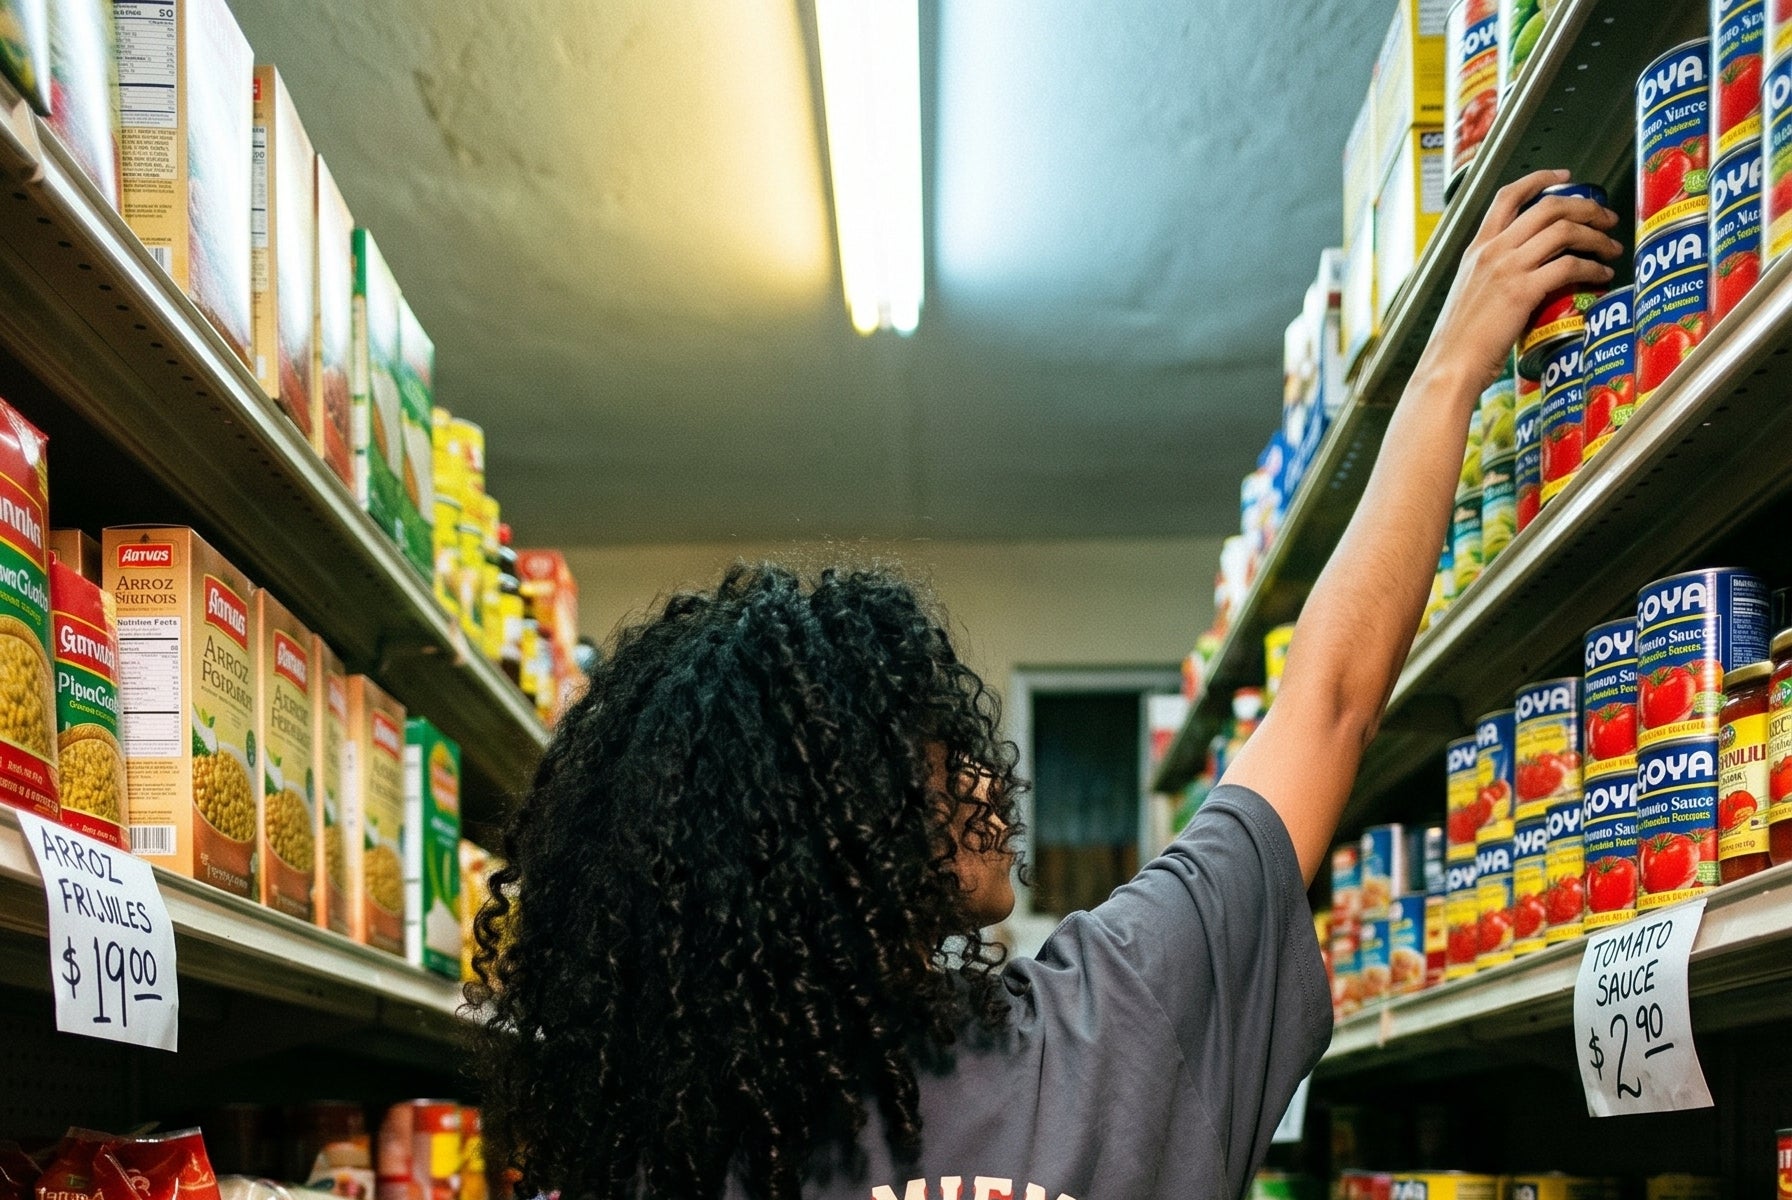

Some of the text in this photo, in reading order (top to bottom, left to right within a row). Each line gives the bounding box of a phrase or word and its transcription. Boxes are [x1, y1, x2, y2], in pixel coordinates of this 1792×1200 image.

[116, 575, 174, 591] ARROZ
[203, 634, 249, 685] ARROZ
[1585, 629, 1637, 669] GOY
[1637, 750, 1714, 794] GOYA
[1671, 796, 1714, 811] Sauce
[40, 825, 124, 886] ARROZ
[1593, 920, 1674, 973] TOMATO
[1595, 958, 1659, 1007] SAUCE
